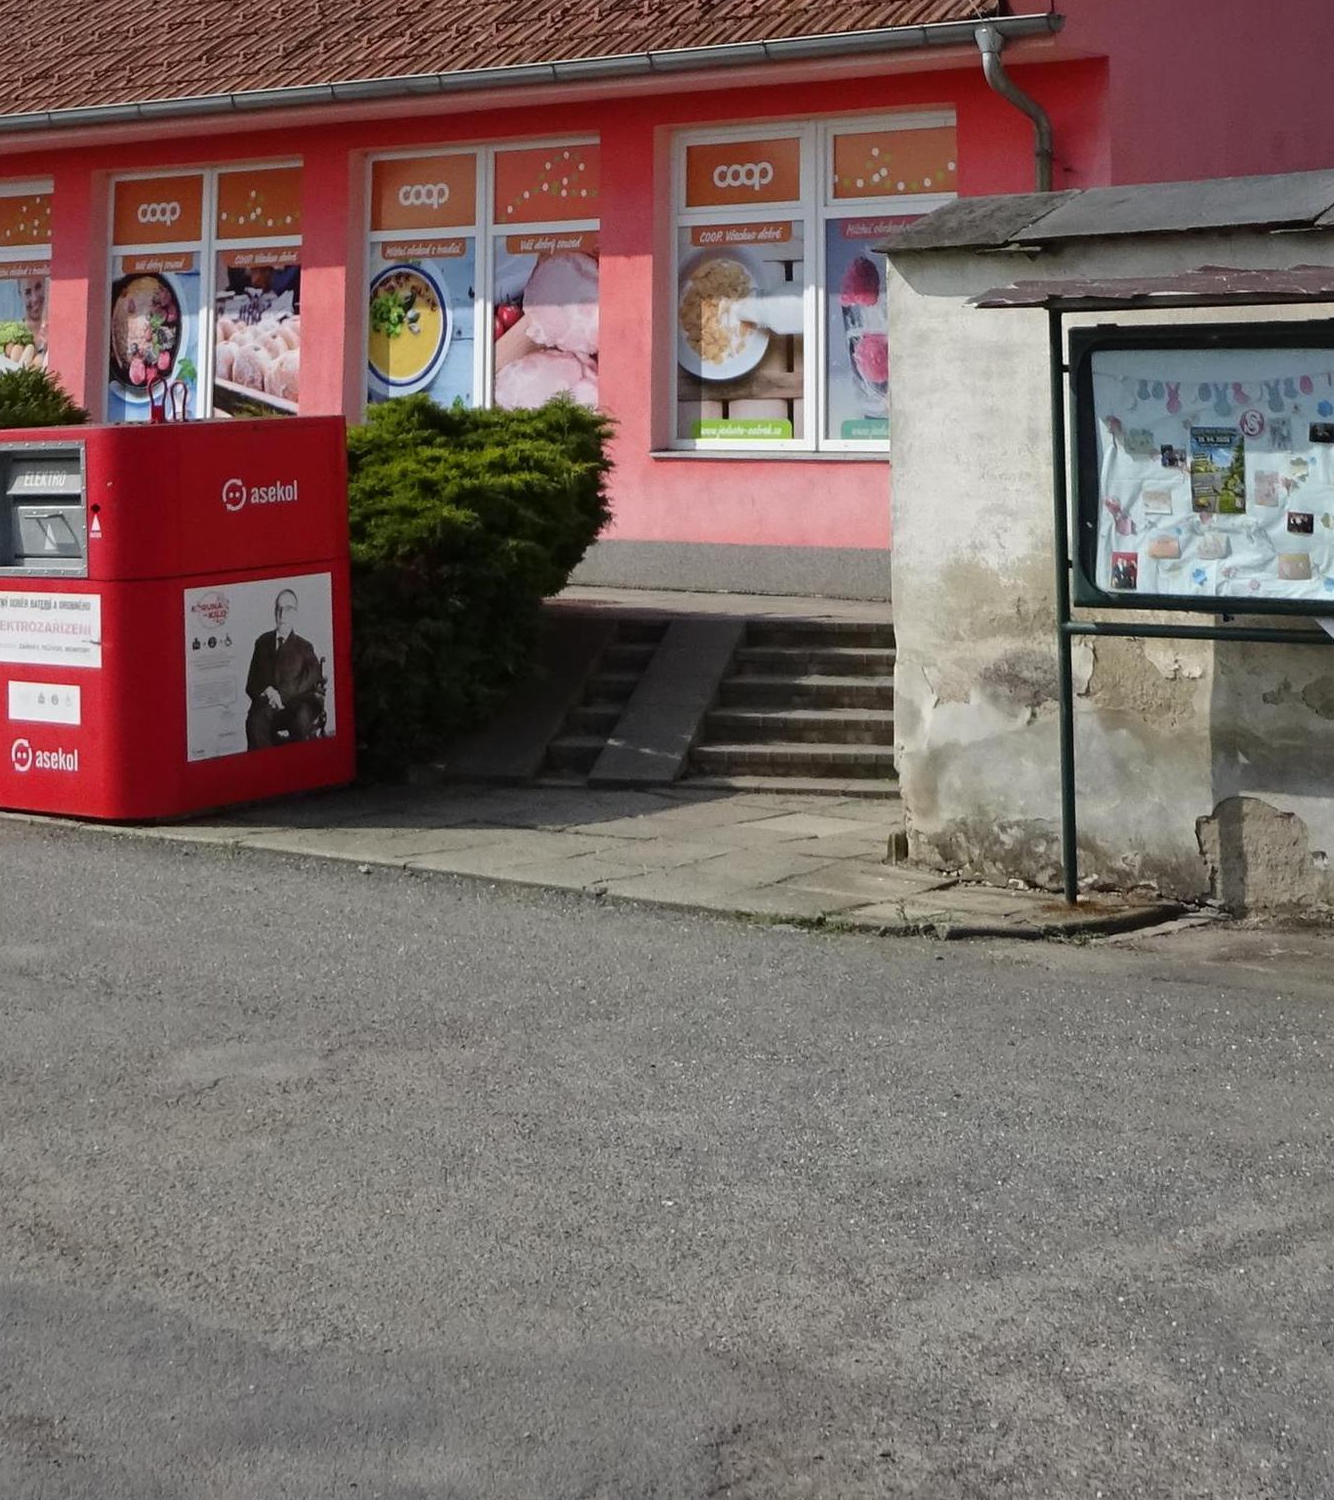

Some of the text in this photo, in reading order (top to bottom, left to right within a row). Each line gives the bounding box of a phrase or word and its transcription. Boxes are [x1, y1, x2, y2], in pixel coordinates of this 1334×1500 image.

[24, 470, 67, 487] ELEKTRO
[250, 479, 298, 504] asekol
[35, 747, 79, 772] asekol
